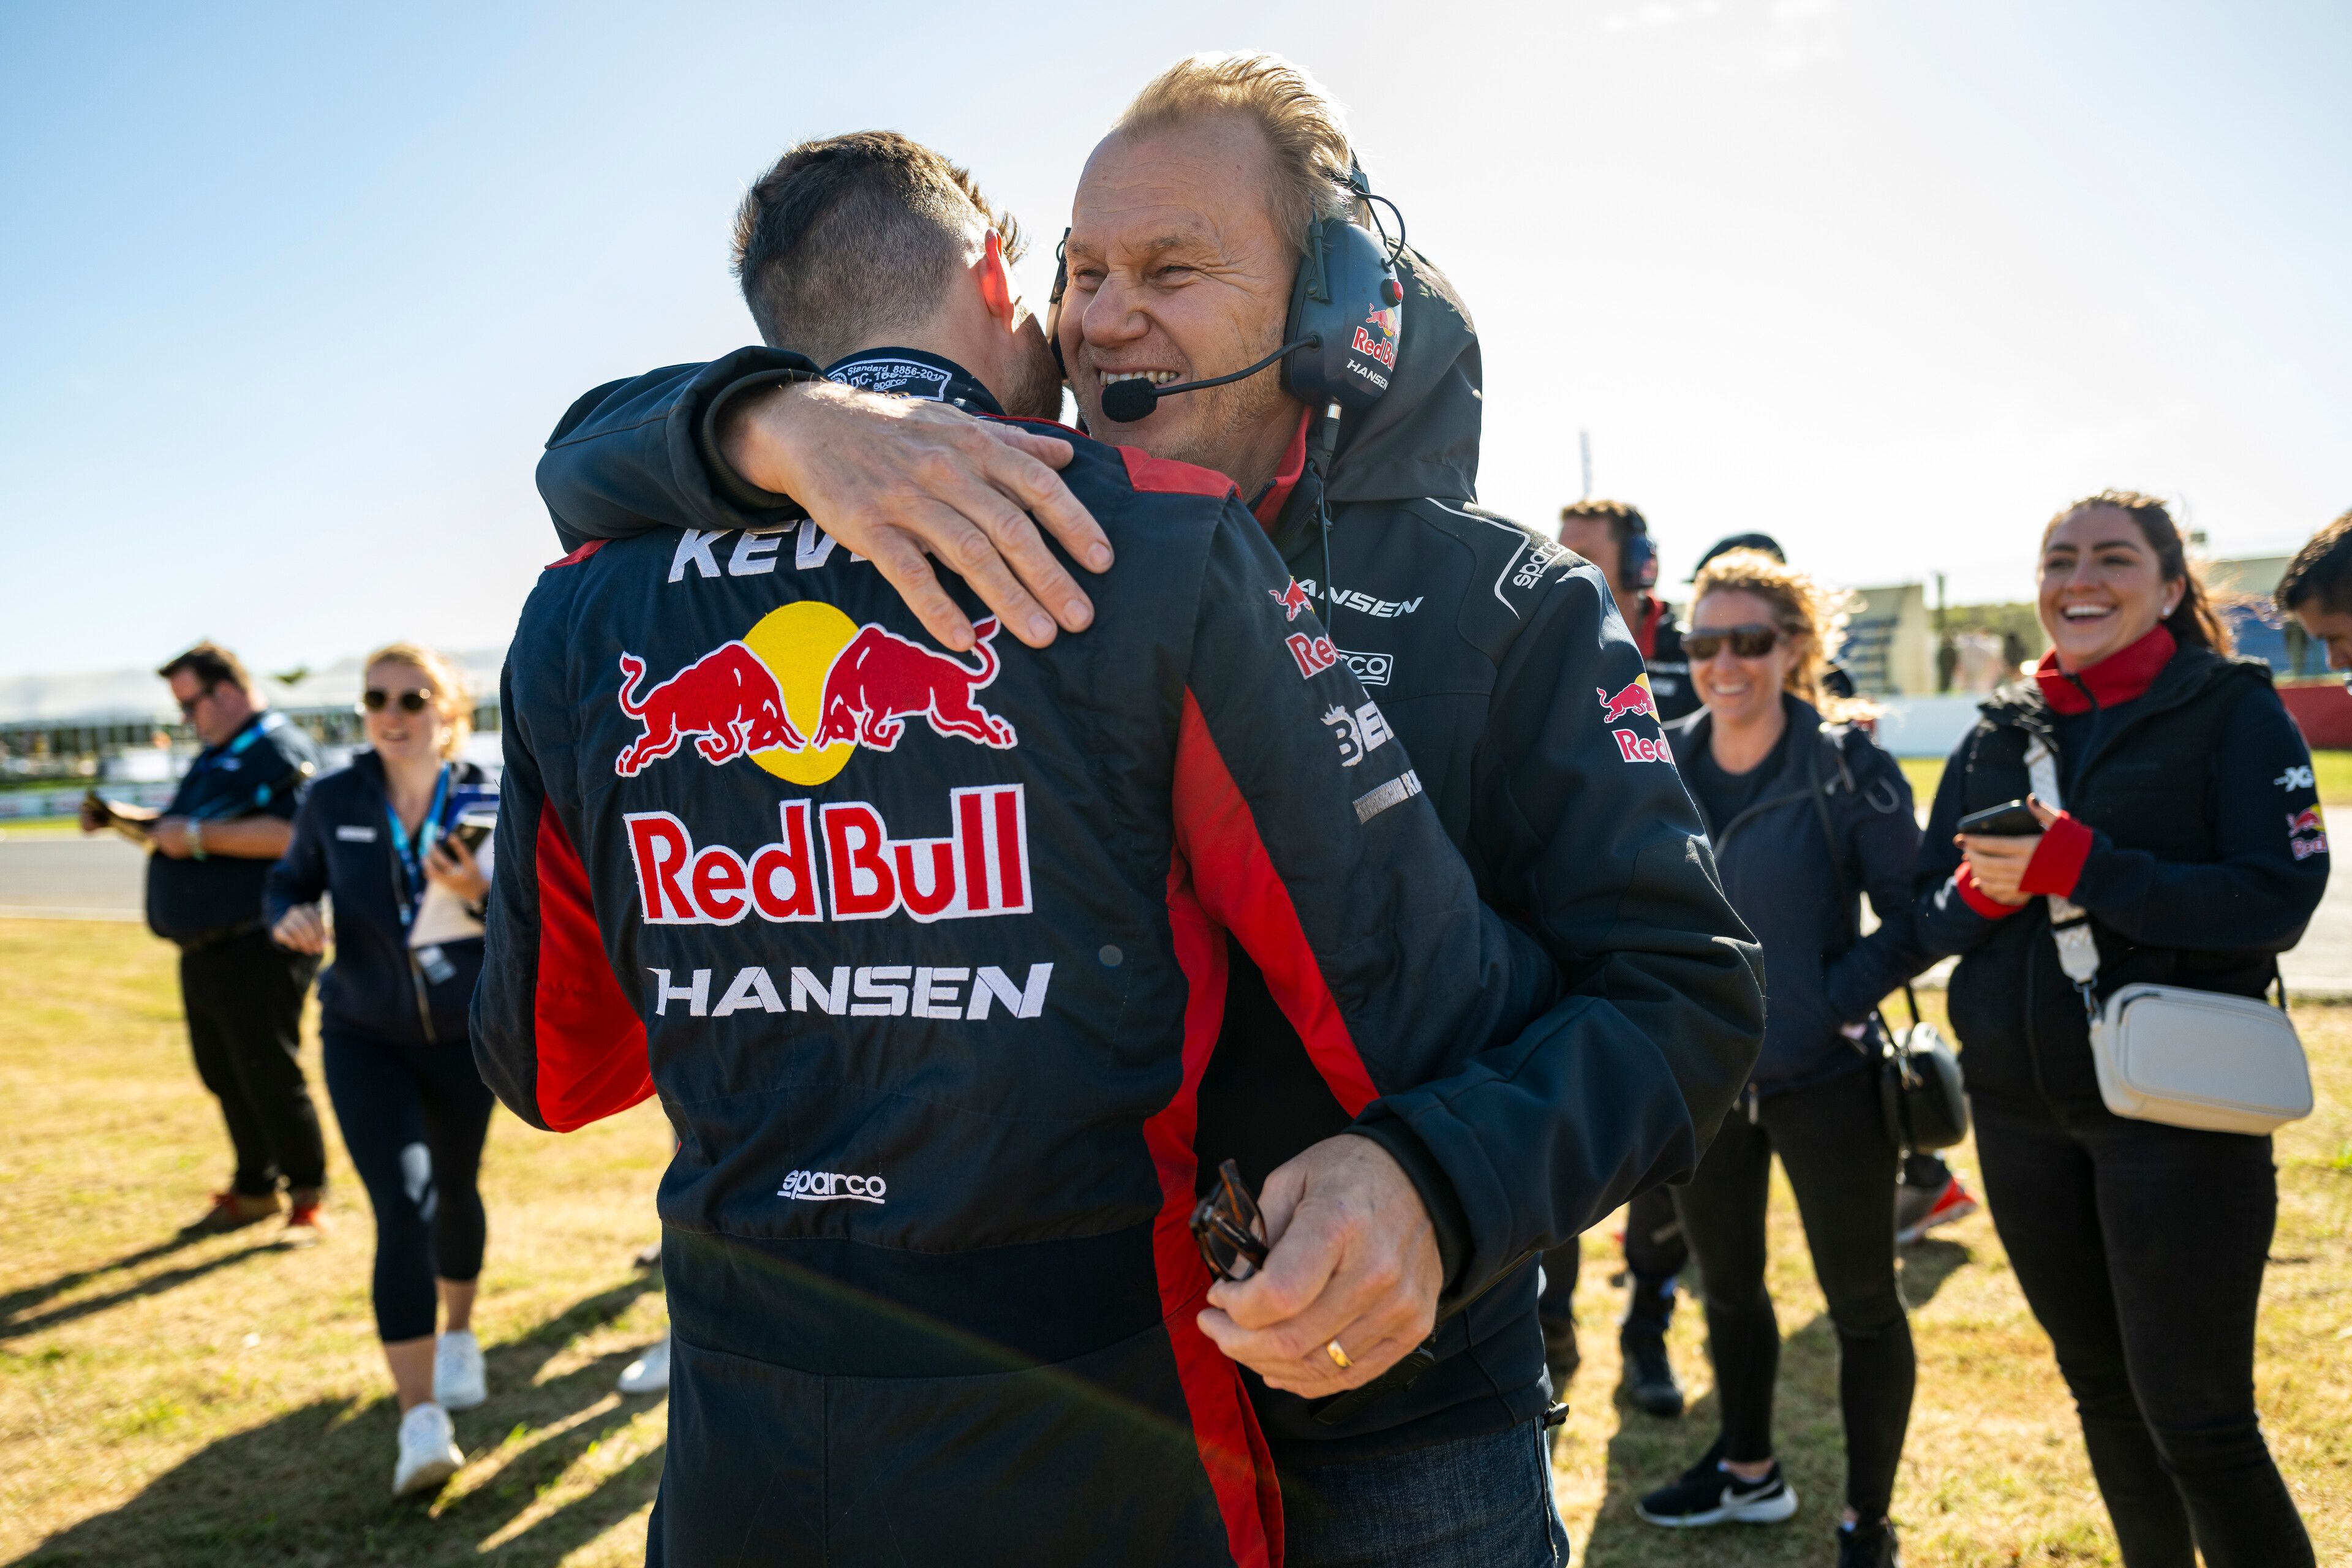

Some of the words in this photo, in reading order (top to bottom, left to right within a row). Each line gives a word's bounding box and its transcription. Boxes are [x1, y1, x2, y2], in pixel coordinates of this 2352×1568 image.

[1352, 326, 1387, 361] Red
[848, 365, 888, 375] Standard
[1347, 358, 1389, 390] HANSEN
[668, 519, 869, 583] KEV
[1297, 579, 1423, 617] ANSEN
[1284, 633, 1343, 680] Re
[624, 798, 823, 925] Red
[820, 783, 1033, 923] Bull
[647, 963, 1054, 1020] HANSEN
[777, 1169, 887, 1204] sparco
